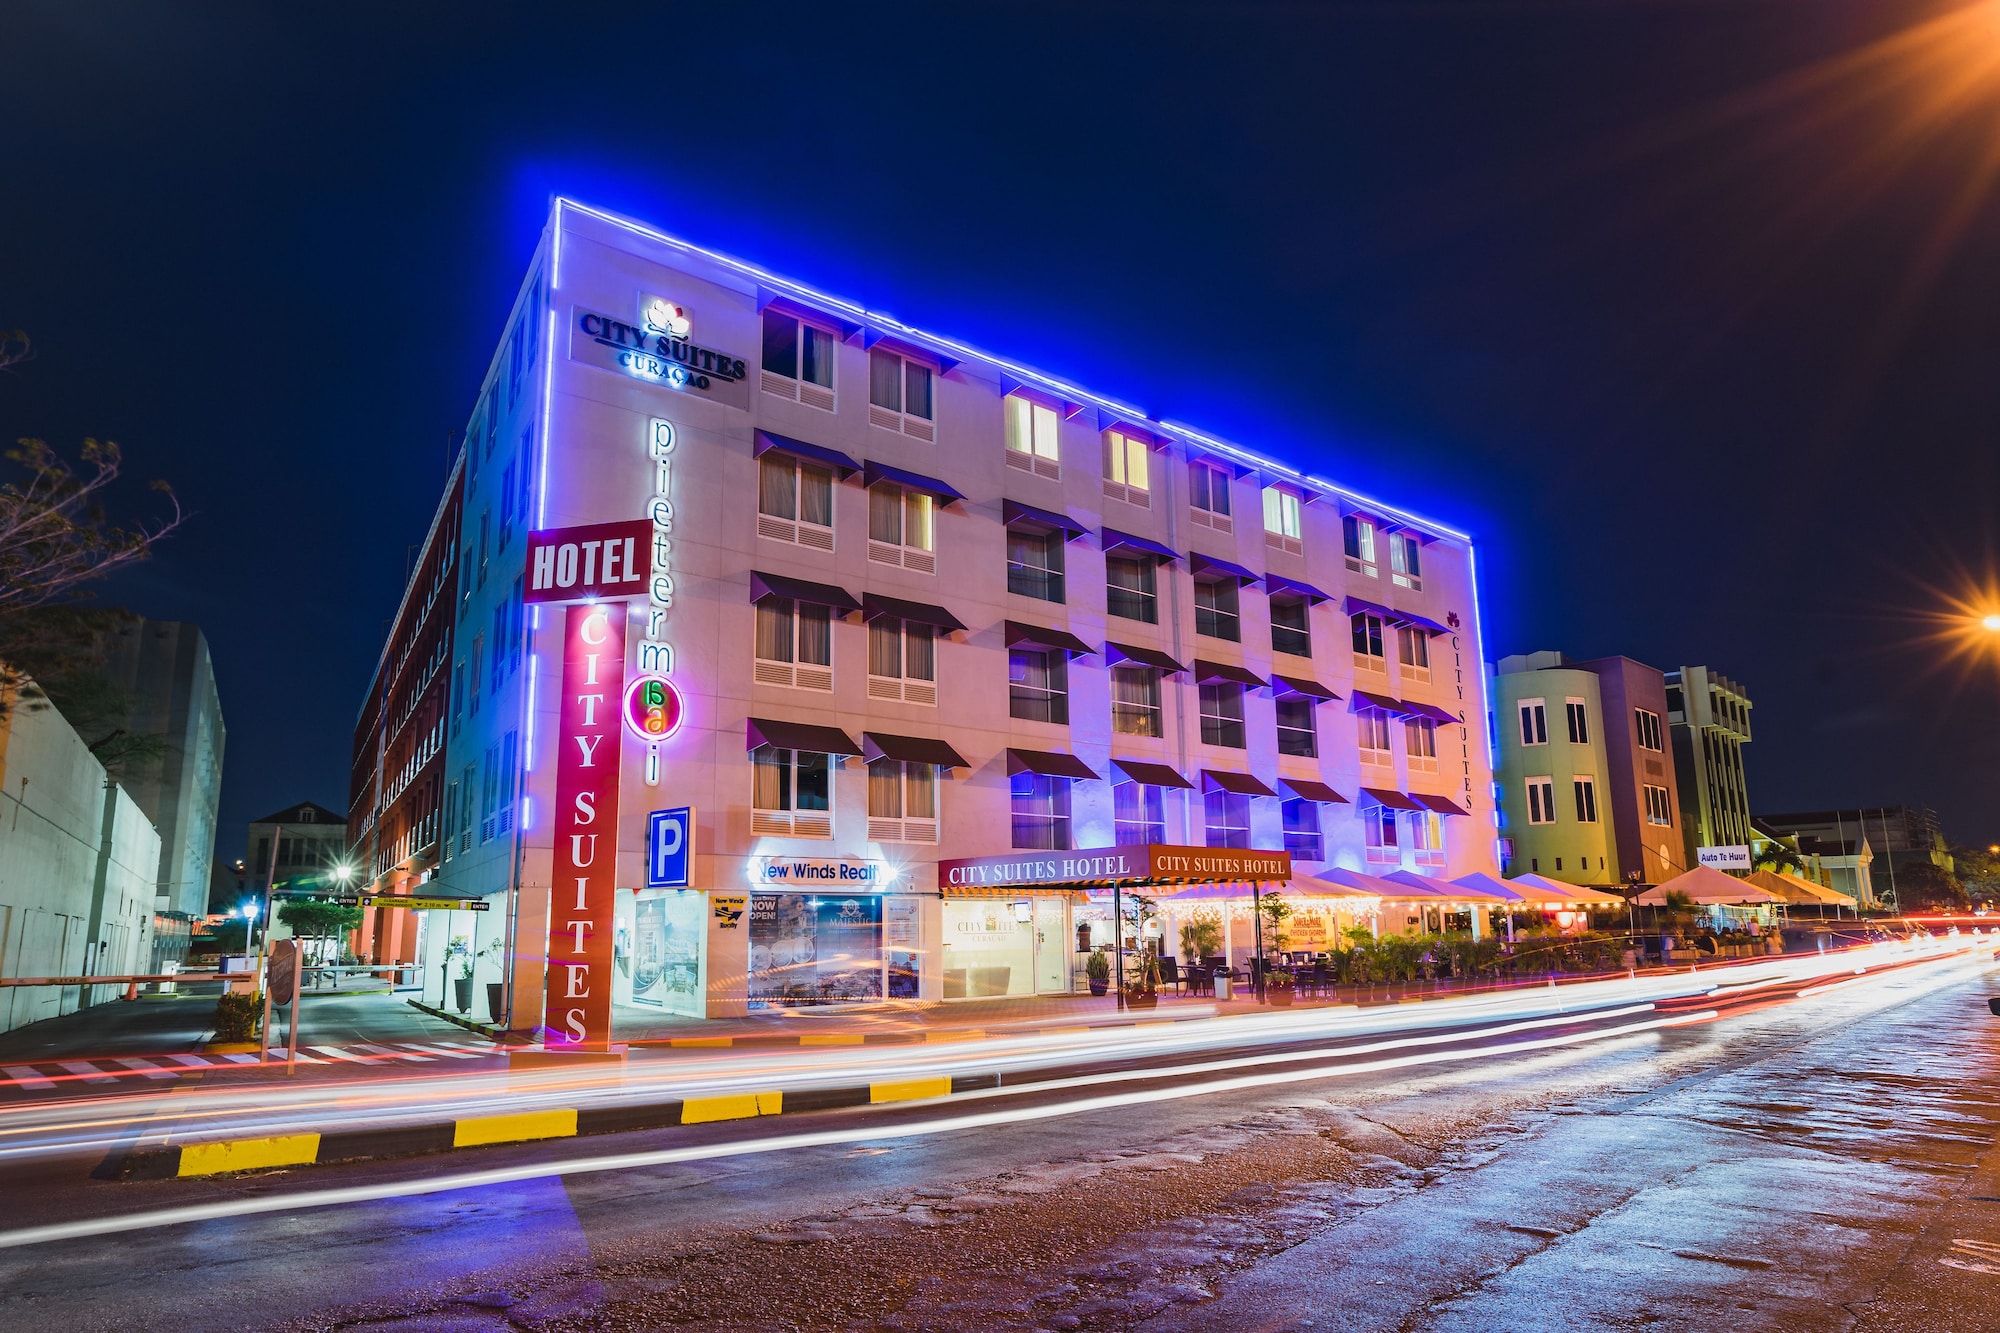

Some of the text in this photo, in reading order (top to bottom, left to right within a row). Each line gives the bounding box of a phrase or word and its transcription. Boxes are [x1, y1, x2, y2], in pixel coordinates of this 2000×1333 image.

[582, 313, 746, 380] CITY SUITES
[618, 352, 710, 390] CURAÇAO
[532, 537, 641, 590] HOTEL
[1452, 636, 1473, 809] CITY SUITES
[563, 611, 609, 1044] CITY SUITES
[657, 818, 683, 878] P
[1701, 852, 1746, 862] Auto Te Huur
[759, 862, 789, 879] New
[793, 863, 836, 879] Winds
[949, 856, 1131, 884] CITY SUITES HOTEL
[1157, 855, 1286, 875] CITY SUITES HOTEL
[750, 901, 776, 910] NOW
[750, 912, 776, 920] OPEN!
[829, 917, 872, 927] MAJESTIC
